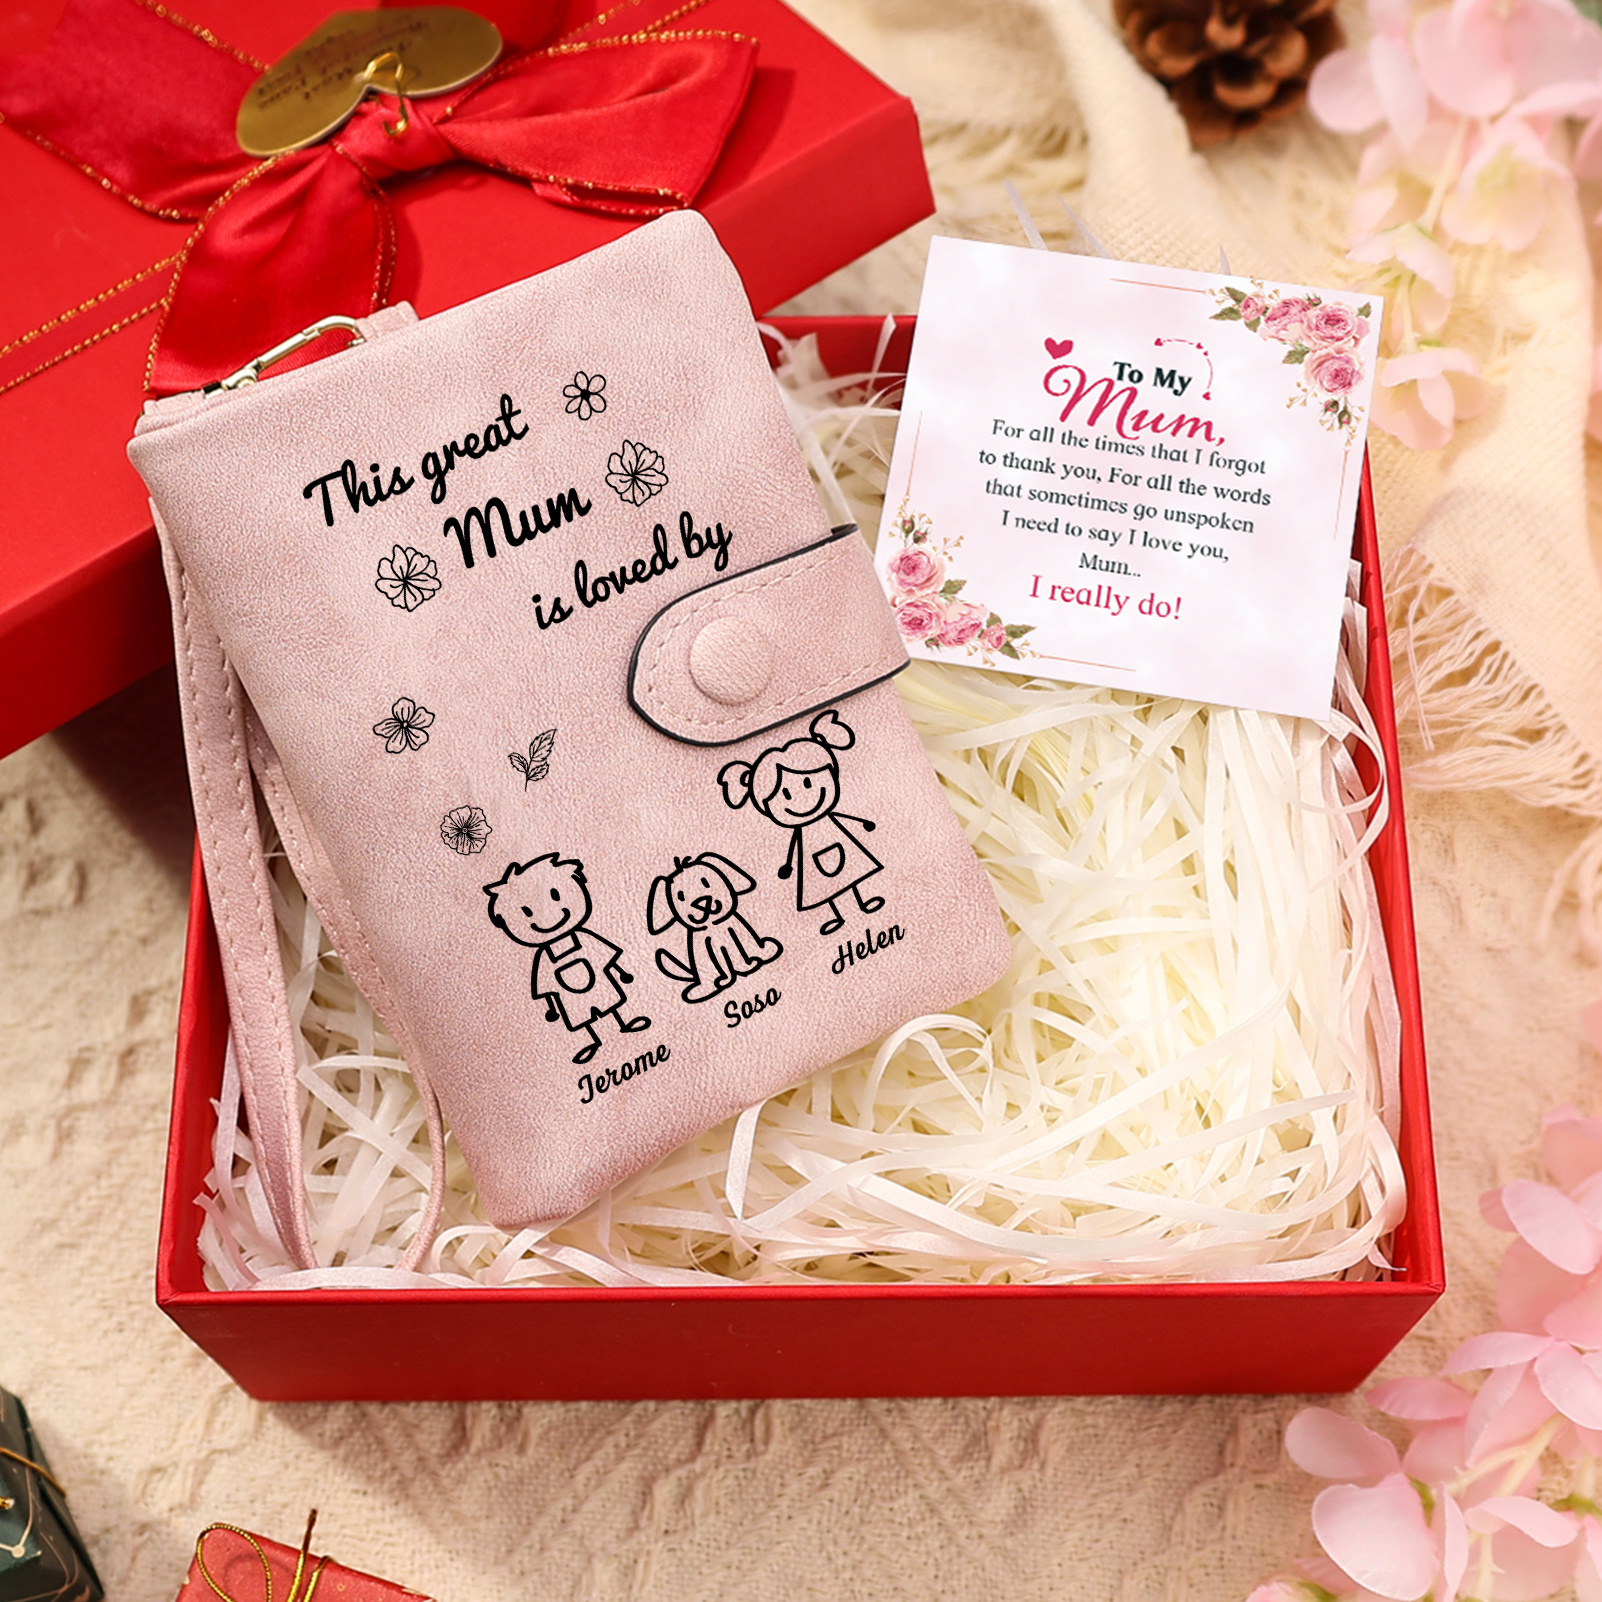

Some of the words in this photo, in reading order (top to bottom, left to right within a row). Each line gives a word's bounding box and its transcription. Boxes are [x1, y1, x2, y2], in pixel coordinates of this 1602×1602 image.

[1043, 364, 1226, 447] Mum,
[1112, 361, 1144, 384] To
[1152, 367, 1193, 397] My
[303, 460, 416, 527] This
[421, 393, 530, 505] great
[992, 419, 1024, 438] For
[1029, 426, 1055, 443] all
[1061, 430, 1089, 448] the
[1095, 435, 1145, 457] times
[1151, 443, 1189, 463] that
[1195, 448, 1203, 464] I
[1209, 450, 1266, 477] forgot
[979, 450, 996, 465] to
[1002, 452, 1056, 474] thank
[1061, 463, 1102, 483] you,
[1108, 467, 1142, 487] For
[1146, 474, 1172, 491] all
[1178, 478, 1207, 496] the
[1213, 486, 1271, 505] words
[443, 487, 593, 569] Mum
[985, 478, 1022, 499] that
[1028, 488, 1128, 514] sometimes
[1133, 503, 1158, 521] go
[1163, 508, 1254, 533] unspoken
[1002, 509, 1010, 526] I
[1015, 516, 1059, 534] need
[1065, 522, 1082, 537] to
[1088, 527, 1122, 547] say
[1129, 529, 1137, 545] I
[1142, 531, 1183, 552] love
[1187, 542, 1229, 563] you,
[532, 594, 574, 630] is
[574, 523, 679, 609] loved
[679, 510, 734, 572] by
[1078, 552, 1141, 577] Mum...
[1029, 574, 1043, 598] I
[1048, 584, 1131, 616] really
[1138, 592, 1182, 620] do!
[831, 924, 906, 975] Helen
[723, 987, 782, 1029] Soso
[577, 1044, 671, 1105] Jerome
